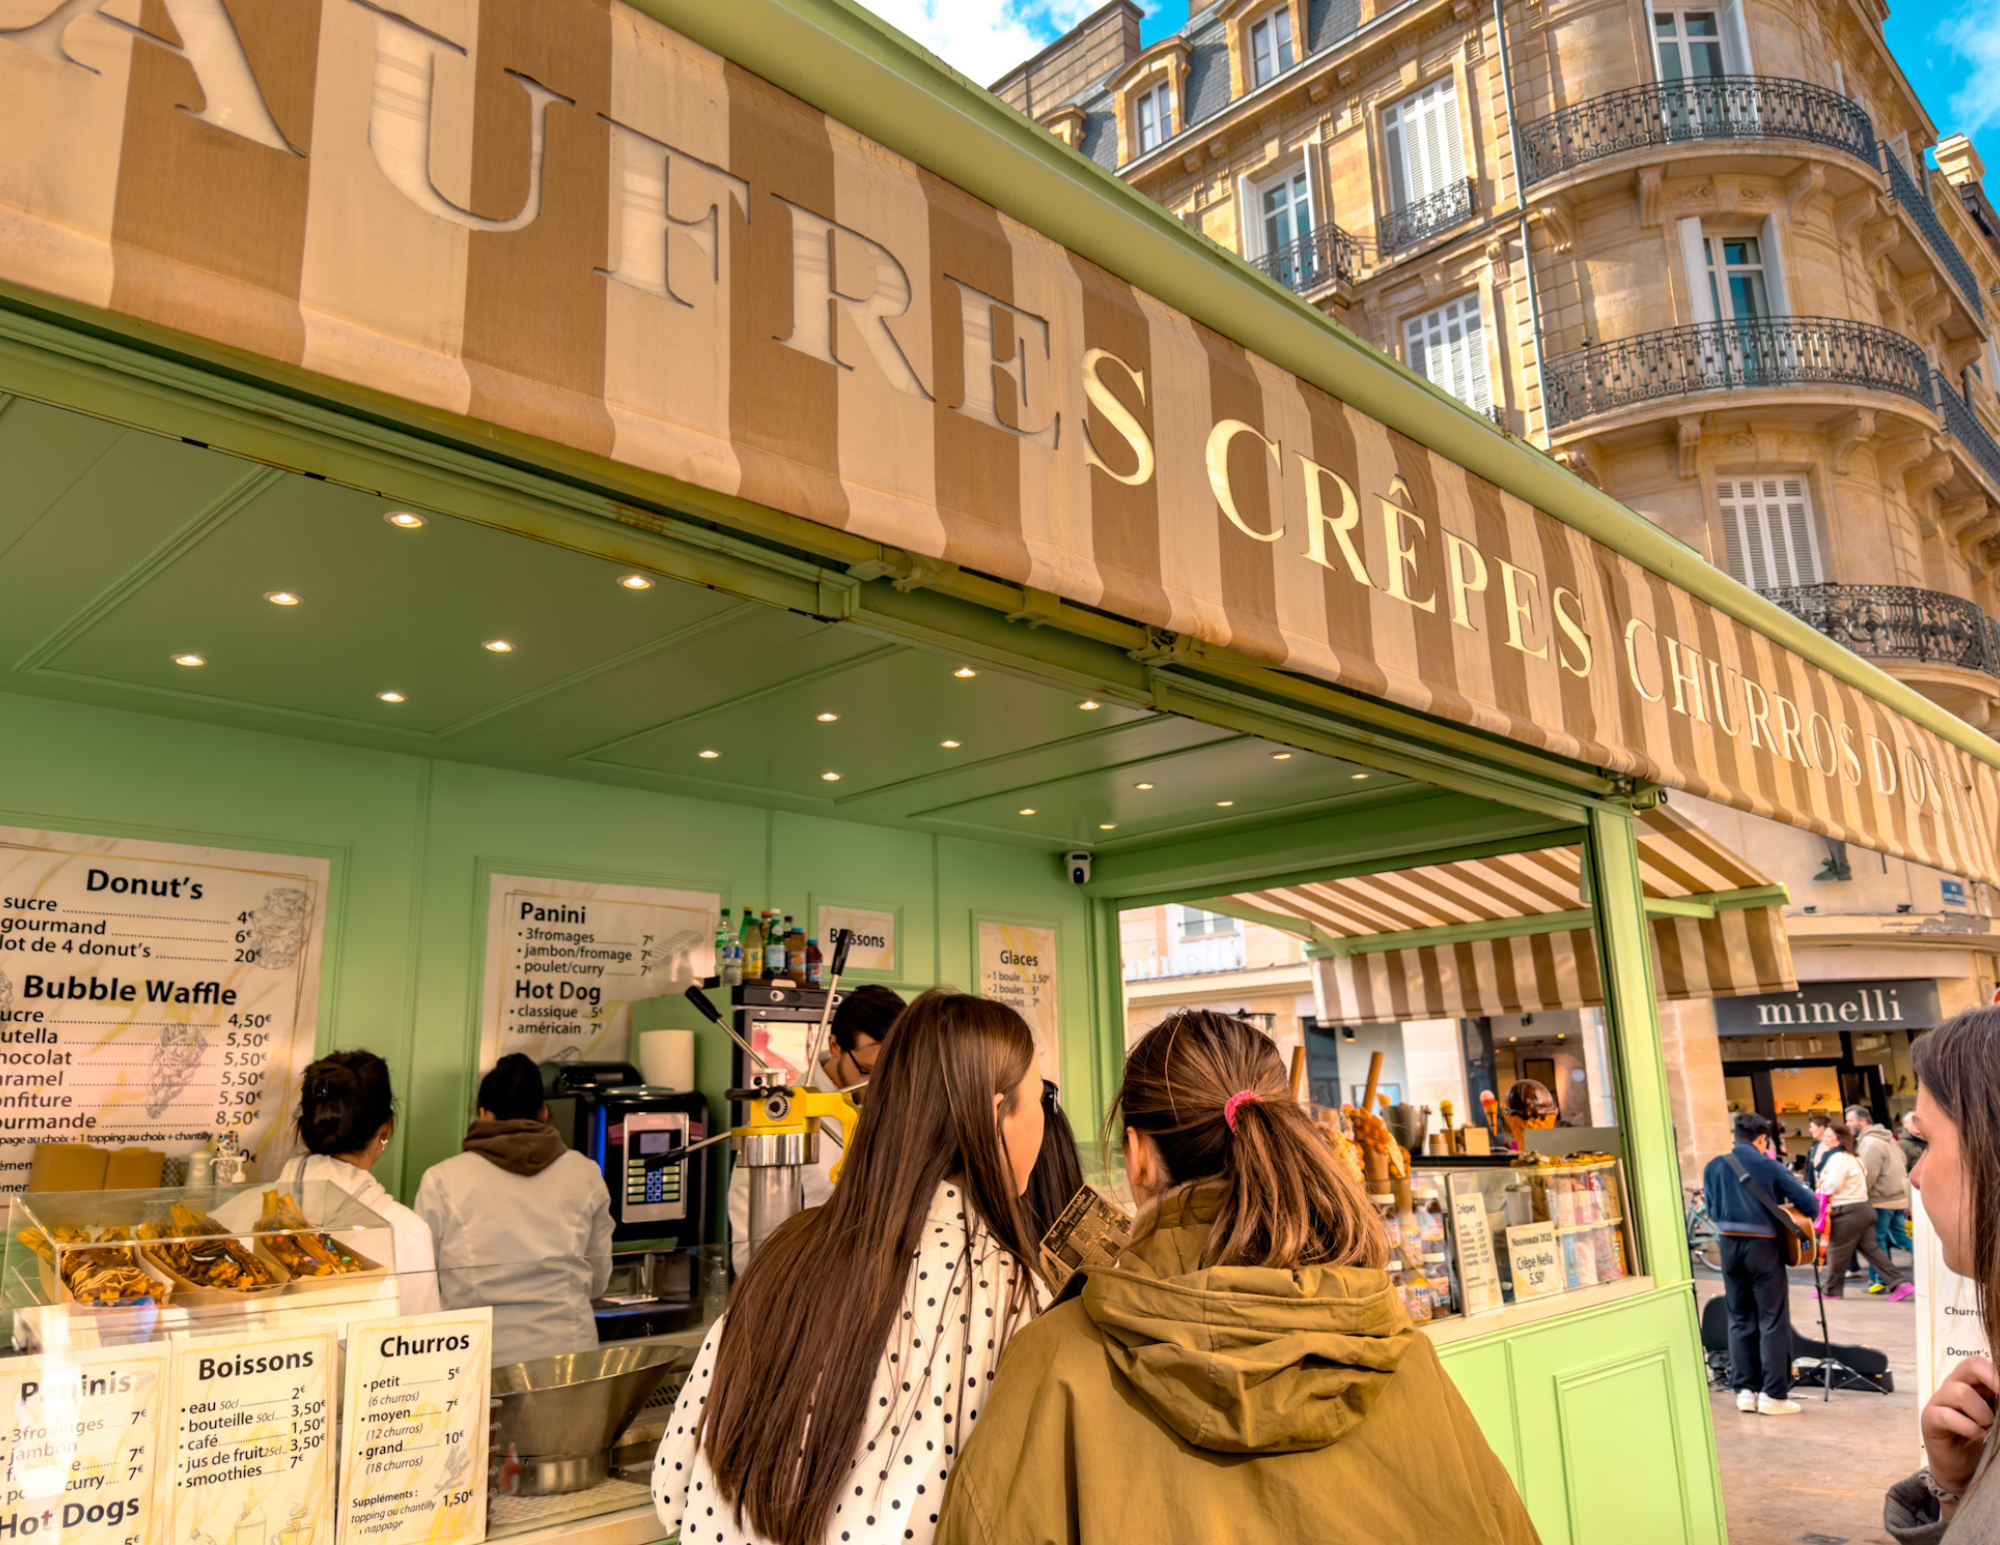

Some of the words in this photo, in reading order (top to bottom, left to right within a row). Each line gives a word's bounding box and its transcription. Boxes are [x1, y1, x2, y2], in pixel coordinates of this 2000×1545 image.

[1205, 418, 1595, 678] CRÊPES
[1624, 617, 1862, 787] CHURROS
[86, 868, 204, 900] Donut's
[3, 896, 58, 912] sucre
[237, 910, 255, 925] 4€
[521, 902, 587, 924] Panini
[1, 918, 107, 936] gourmand
[235, 929, 253, 944] 6€
[525, 927, 595, 946] 3fromages
[829, 928, 885, 949] Bssons
[0, 934, 26, 951] lot
[31, 936, 56, 953] de
[61, 939, 73, 954] 4
[79, 939, 152, 958] donut's
[233, 948, 263, 963] 20€
[524, 943, 633, 964] jambon/fromage
[1000, 949, 1039, 967] Glaces
[524, 961, 605, 978] poulet/curry
[998, 970, 1021, 982] boule
[23, 975, 136, 1001] Bubble
[145, 979, 237, 1005] Waffle
[515, 980, 555, 999] Hot
[559, 981, 602, 1006] Dog
[999, 983, 1024, 995] boules
[517, 1004, 578, 1021] classique
[1757, 988, 1904, 1026] minelli
[227, 1013, 272, 1029] 4,50€
[516, 1021, 582, 1035] américain
[225, 1032, 270, 1048] 5,50€
[223, 1052, 267, 1067] 5,50€
[221, 1071, 266, 1087] 5,50€
[218, 1090, 264, 1107] 5,50€
[215, 1110, 260, 1127] 8,50€
[87, 1134, 126, 1145] topping
[1516, 1256, 1537, 1271] Crêpe
[380, 1334, 470, 1358] Churros
[199, 1350, 314, 1381] Boissons
[370, 1376, 400, 1392] petit
[447, 1367, 460, 1380] 5€
[189, 1402, 216, 1414] eau
[219, 1399, 240, 1411] 50cl
[291, 1385, 306, 1400] 2€
[368, 1396, 379, 1407] (6
[379, 1391, 420, 1406] churros)
[131, 1409, 147, 1425] 7€
[188, 1412, 254, 1433] bouteille
[256, 1411, 275, 1424] 50cl
[291, 1399, 326, 1418] 3,50€
[368, 1408, 411, 1424] moyen
[446, 1398, 459, 1413] 7€
[187, 1434, 218, 1451] café
[291, 1416, 326, 1435] 1,50€
[366, 1428, 383, 1442] (12
[383, 1423, 423, 1438] churros)
[8, 1441, 78, 1466] jambon
[129, 1445, 145, 1462] 7€
[185, 1457, 208, 1473] jus
[211, 1452, 231, 1467] de
[233, 1446, 264, 1462] fruit
[290, 1433, 326, 1452] 3,50€
[366, 1440, 404, 1460] grand
[444, 1430, 465, 1445] 10€
[128, 1464, 144, 1481] 7€
[186, 1465, 262, 1488] smoothies
[290, 1454, 304, 1469] 7€
[365, 1462, 383, 1475] (18
[383, 1455, 423, 1472] churros)
[350, 1509, 385, 1524] topping
[386, 1507, 399, 1517] ou
[399, 1500, 436, 1515] chantilly
[443, 1489, 474, 1508] 1,50€
[352, 1490, 413, 1508] Suppléments
[0, 1509, 53, 1541] Hot
[62, 1497, 140, 1528] Dogs
